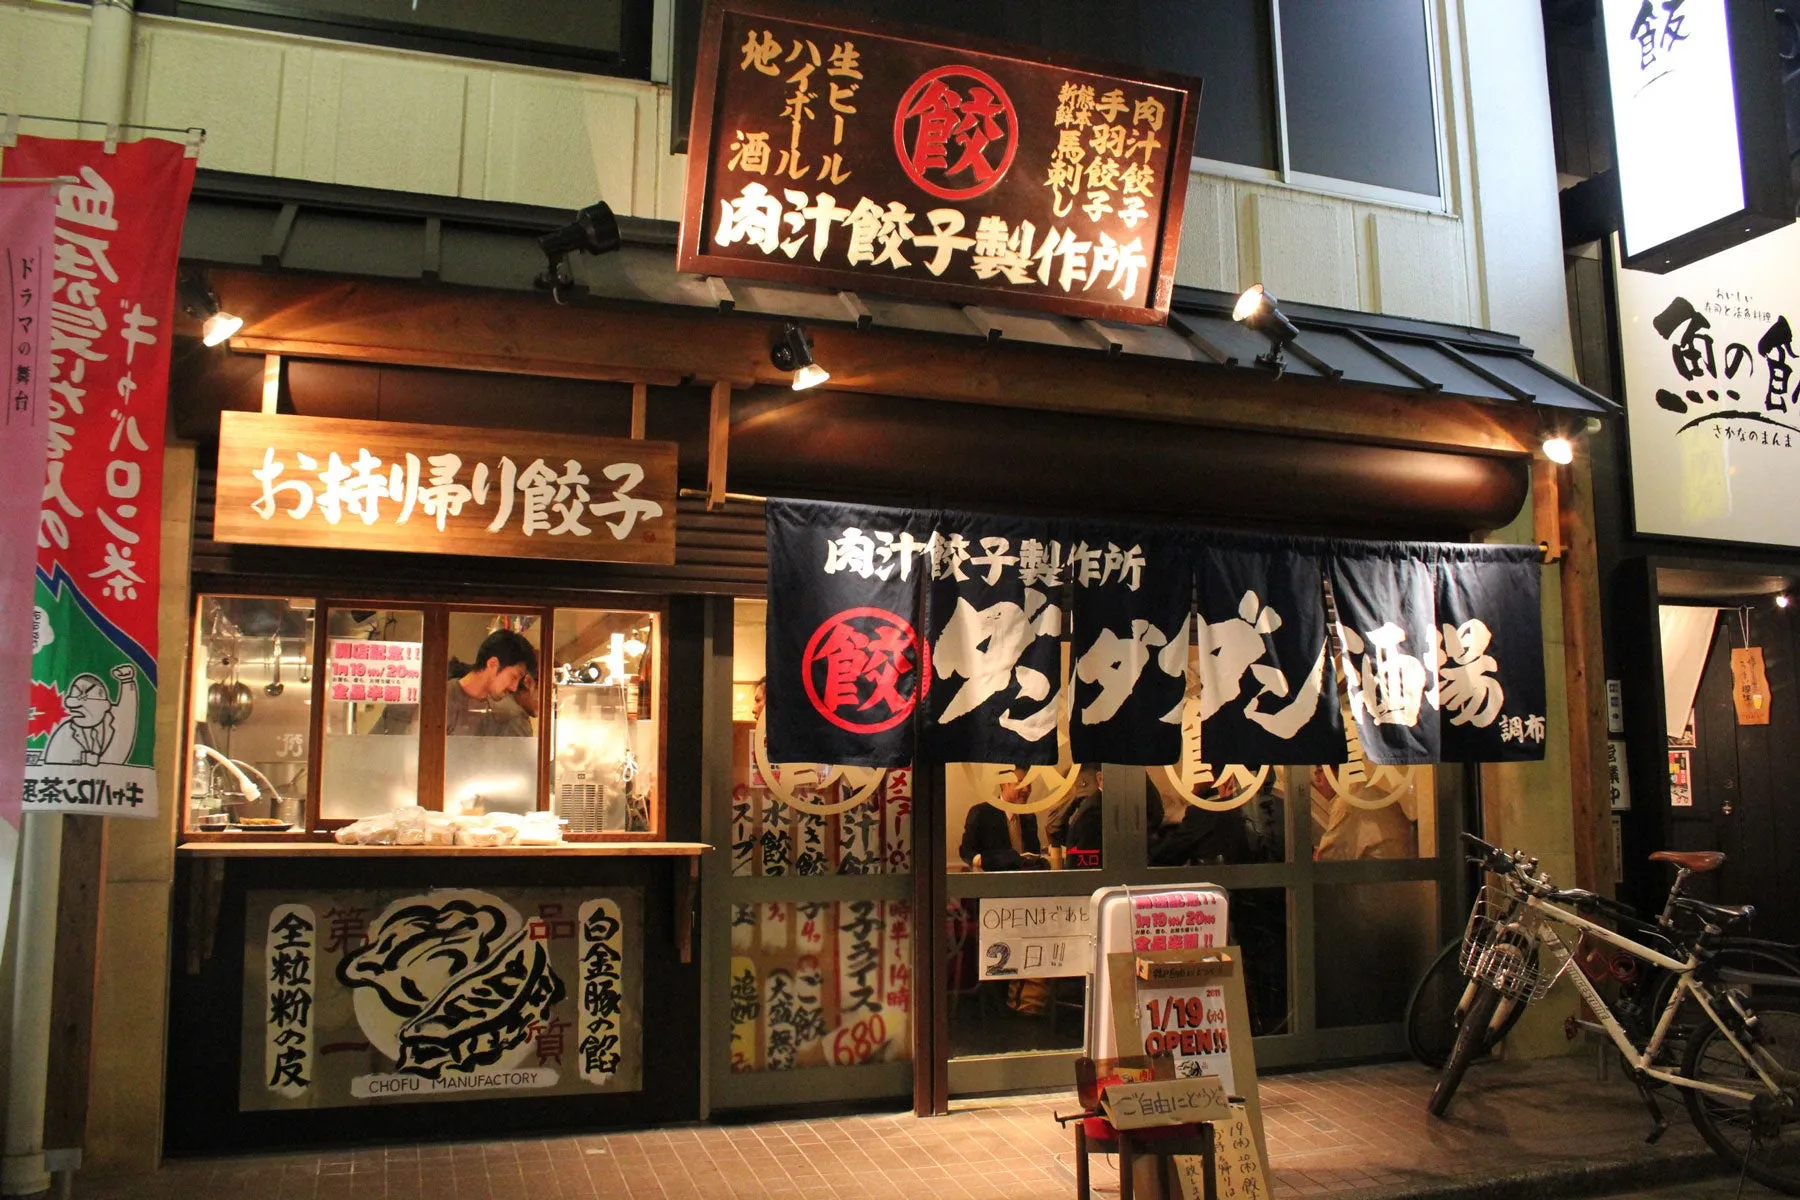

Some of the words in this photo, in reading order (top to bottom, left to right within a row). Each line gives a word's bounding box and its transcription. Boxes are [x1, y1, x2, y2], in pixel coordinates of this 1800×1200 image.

[774, 40, 822, 180] ハイボール
[816, 41, 864, 185] 生ビール
[905, 81, 1006, 182] 餃
[1043, 129, 1086, 217] 馬刺し
[1081, 88, 1130, 222] 手羽餃子
[1117, 96, 1165, 228] 肉汁餃子
[714, 182, 1148, 300] 肉汁餃子製作所
[1717, 288, 1752, 302] おいしい
[15, 258, 33, 411] ドラマの舞台
[1713, 424, 1792, 448] さかなのまんま
[824, 526, 1146, 592] 肉汁餃子製作所
[811, 622, 914, 713] 餃
[1500, 713, 1546, 745] 調布
[888, 767, 912, 837] メニュー
[1077, 855, 1099, 867] 入口
[269, 911, 313, 1089] 全粒粉の皮
[579, 907, 622, 1074] 白金豚の餡
[1146, 996, 1203, 1031] 1/19
[1206, 989, 1221, 998] 2011
[1563, 960, 1611, 1020] RIDGESTONE
[834, 1013, 886, 1066] 680
[1145, 1028, 1228, 1059] OPEN!!
[369, 1078, 420, 1094] CHOFU
[431, 1071, 538, 1089] MANUFACTORY
